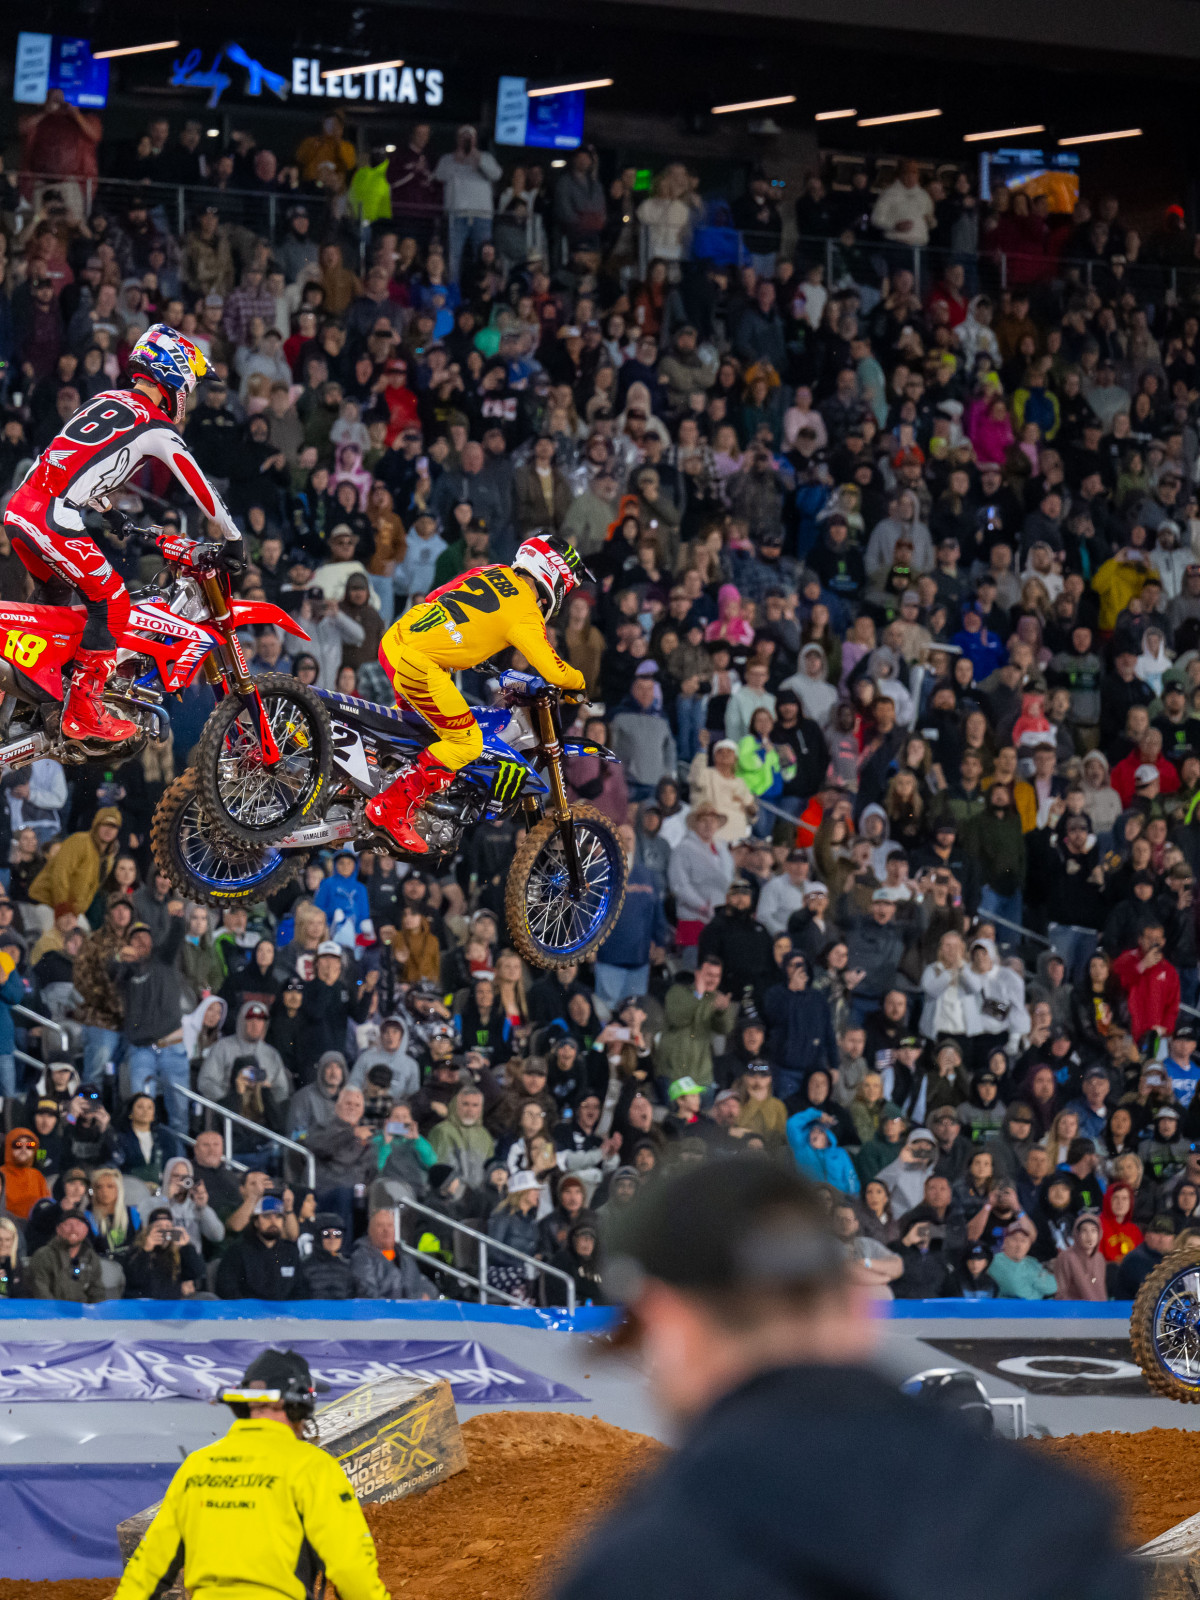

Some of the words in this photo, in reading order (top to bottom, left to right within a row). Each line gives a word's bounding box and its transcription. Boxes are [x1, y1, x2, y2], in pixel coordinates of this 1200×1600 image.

[292, 57, 444, 106] ELECTRA'S
[48, 562, 78, 588] HONDA
[482, 566, 520, 598] WEBB
[544, 549, 575, 588] 100%
[437, 576, 500, 625] 2
[134, 615, 202, 640] HONDA
[3, 629, 48, 669] 18
[230, 634, 250, 674] SHOWA
[340, 703, 360, 715] YAMAHA
[301, 775, 324, 816] DUNLOP
[302, 829, 330, 841] YAMALUBE
[209, 889, 251, 899] DUNLOP
[379, 1463, 445, 1505] CHAMPIONSHIP
[206, 1500, 256, 1509] SUZUKI
